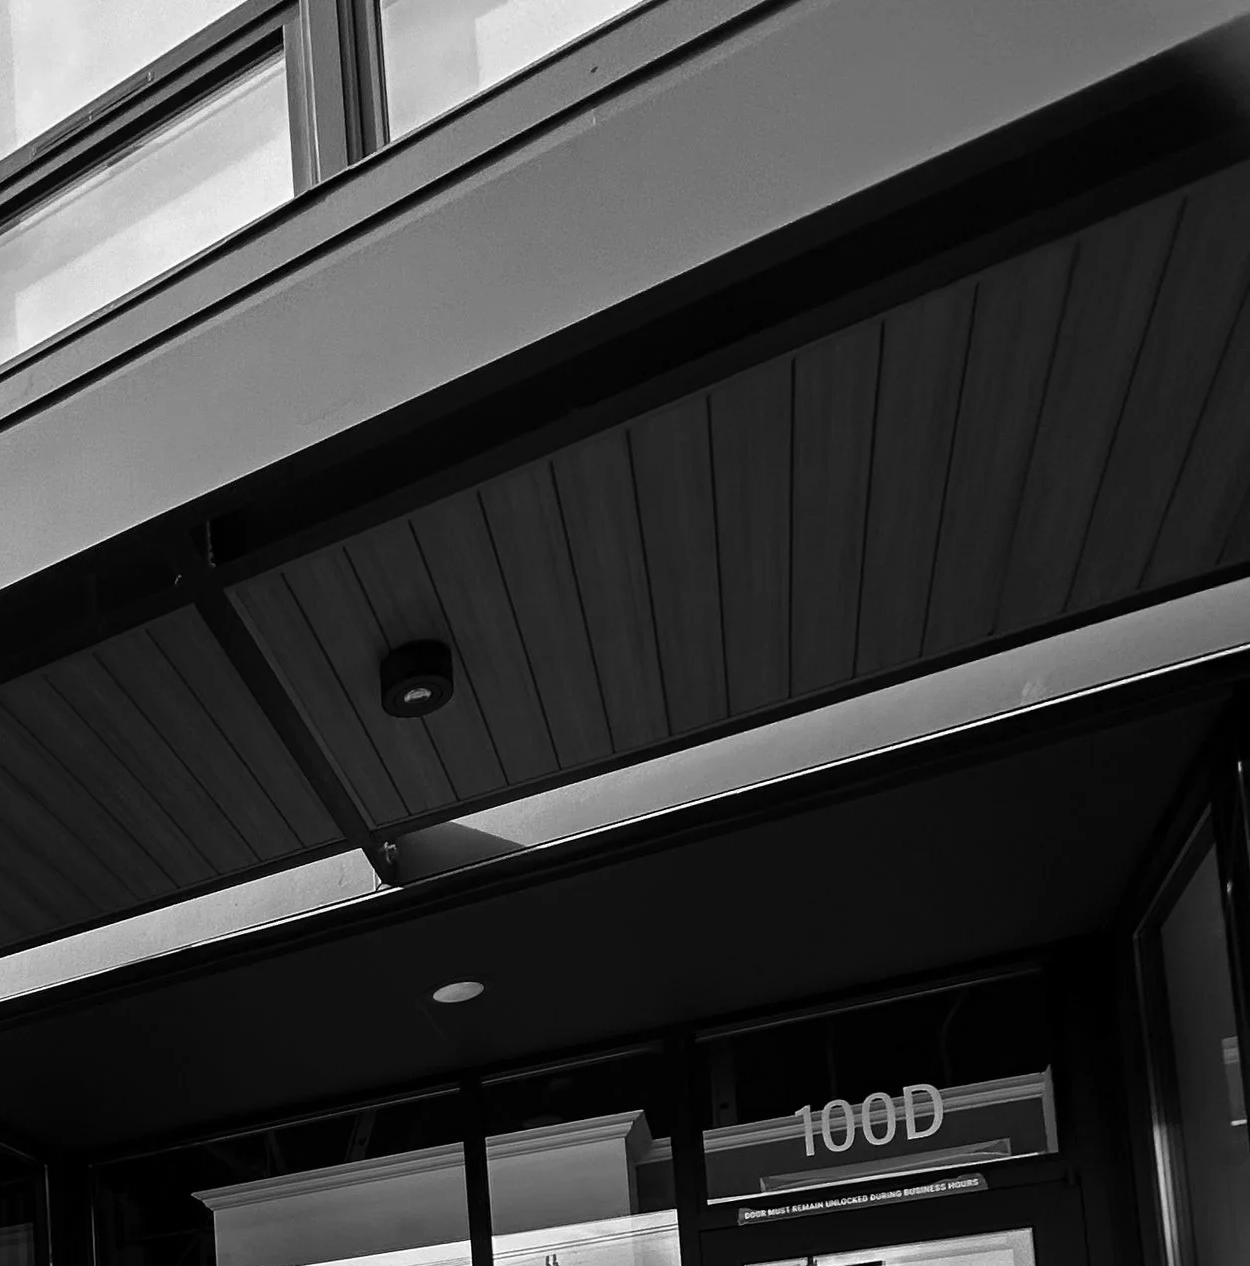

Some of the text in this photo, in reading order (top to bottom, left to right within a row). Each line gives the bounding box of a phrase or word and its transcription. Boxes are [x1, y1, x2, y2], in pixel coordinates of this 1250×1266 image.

[794, 1083, 944, 1157] 100D
[744, 1178, 979, 1220] DOOR MUST REMAIN UNLOCKED DURING BUSINESS HOURS
